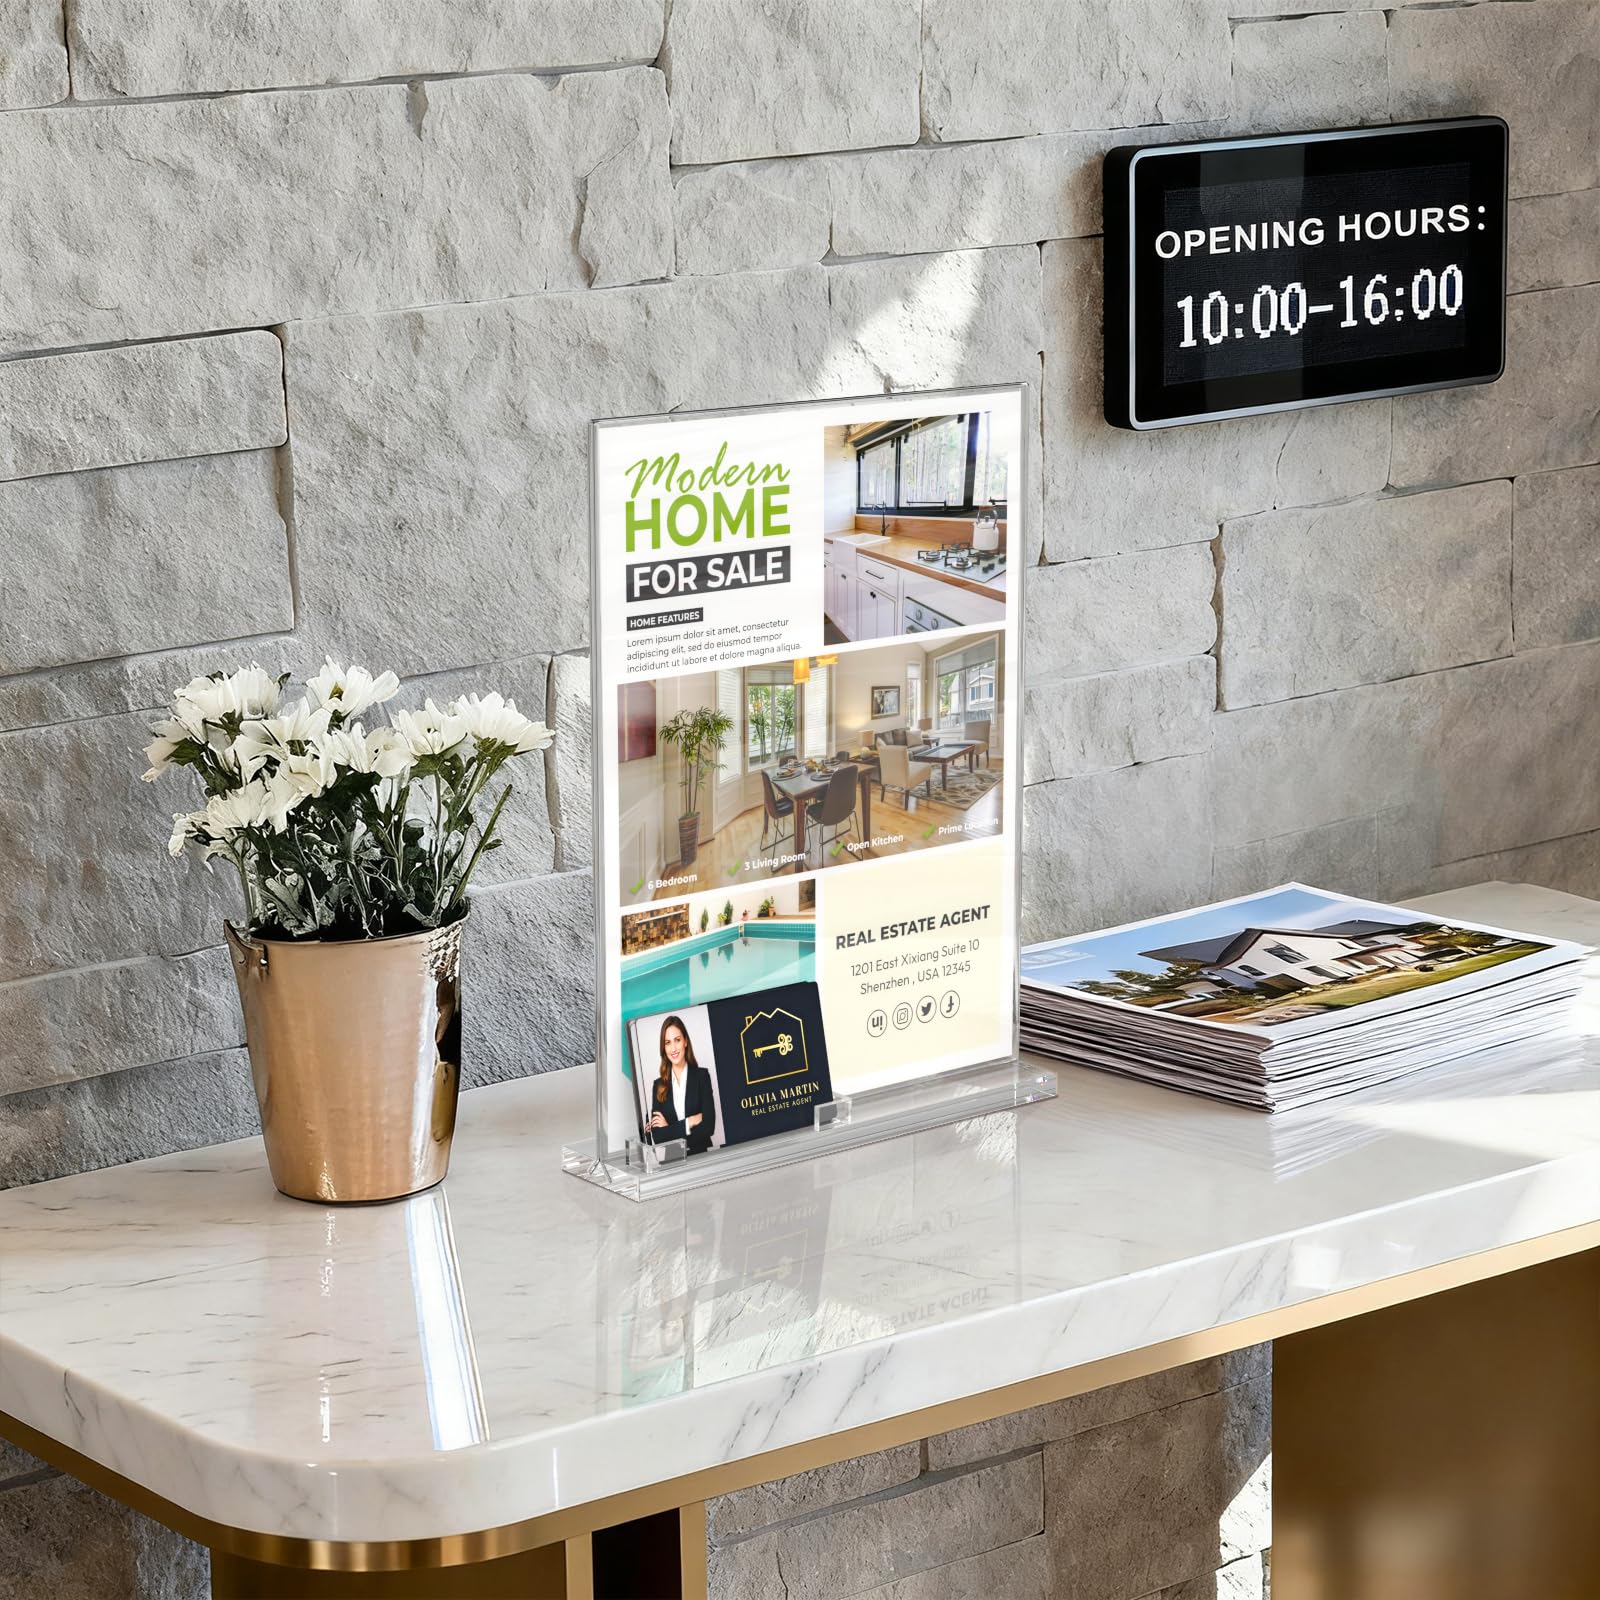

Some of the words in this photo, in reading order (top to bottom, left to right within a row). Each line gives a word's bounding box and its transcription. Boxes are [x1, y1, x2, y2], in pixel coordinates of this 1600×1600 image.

[1154, 218, 1325, 259] OPENING
[1338, 204, 1486, 243] HOURS:
[624, 440, 791, 499] Modern
[625, 484, 791, 553] HOME
[633, 561, 698, 598] FOR
[706, 550, 784, 588] SALE
[627, 637, 653, 648] Lorem
[655, 634, 681, 646] ipsum
[683, 629, 704, 640] dolor
[706, 627, 716, 637] sit
[717, 625, 741, 635] amet,
[742, 619, 789, 632] consectetur
[630, 617, 656, 628] HOME
[657, 611, 700, 624] FEATURES
[626, 647, 669, 661] adipiscing
[671, 645, 686, 655] elit,
[687, 642, 702, 653] sed
[704, 641, 715, 650] do
[716, 635, 751, 648] eiusmod
[753, 633, 783, 643] tempor
[627, 660, 669, 673] incididunt
[671, 659, 680, 667] ut
[682, 655, 708, 666] labore
[709, 654, 718, 662] et
[719, 650, 745, 660] dolore
[746, 646, 775, 657] magna
[847, 841, 870, 853] Open
[871, 834, 904, 847] Kitchen
[938, 824, 963, 836] Prime
[744, 861, 751, 871] 3
[752, 855, 779, 870] Living
[781, 852, 807, 864] Room
[647, 880, 654, 890] 6
[655, 873, 698, 889] Bedroom
[835, 929, 876, 950] REAL
[880, 916, 936, 940] ESTATE
[939, 904, 991, 928] AGENT
[851, 961, 873, 977] 1201
[875, 956, 898, 972] East
[901, 950, 939, 967] Xixiang
[941, 944, 967, 958] Suite
[968, 938, 980, 951] 10
[860, 975, 910, 995] Shenzhen
[917, 967, 939, 982] USA
[942, 960, 971, 977] 12345
[740, 1092, 777, 1109] OLIVIA
[780, 1081, 820, 1099] MARTIN
[751, 1107, 767, 1116] REAL
[768, 1101, 790, 1113] ESTATE
[792, 1095, 812, 1107] AGENT
